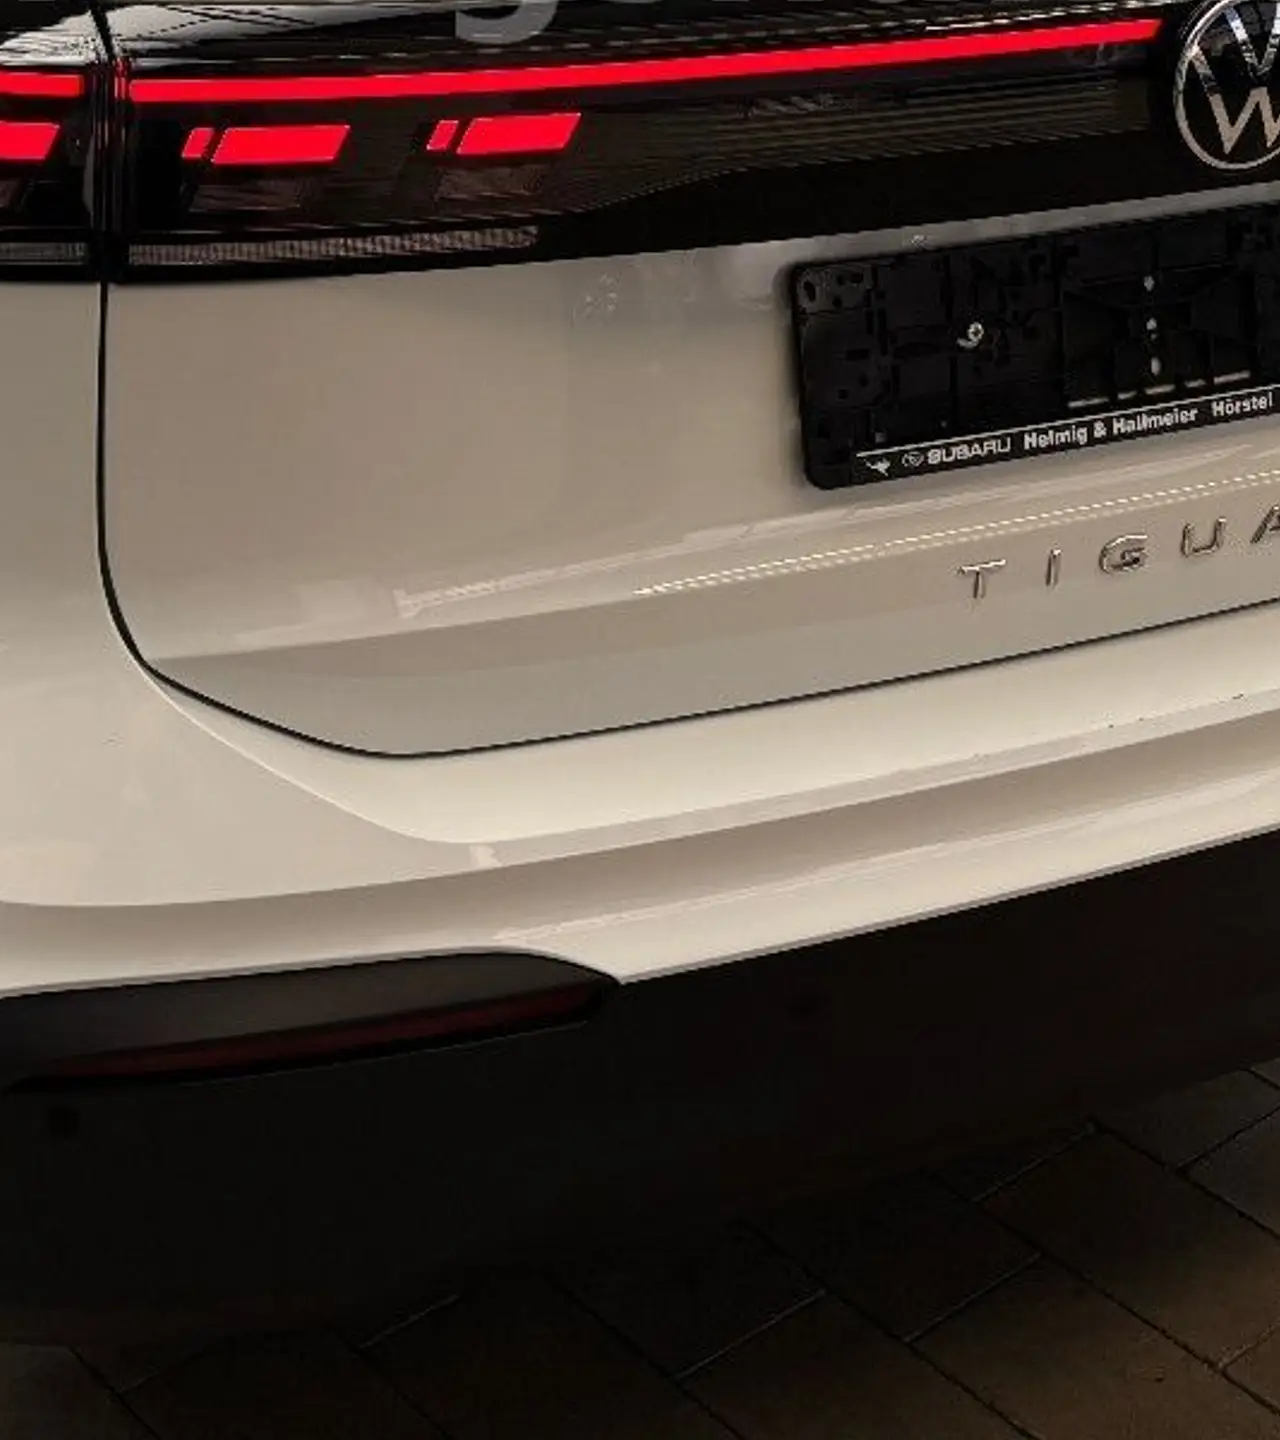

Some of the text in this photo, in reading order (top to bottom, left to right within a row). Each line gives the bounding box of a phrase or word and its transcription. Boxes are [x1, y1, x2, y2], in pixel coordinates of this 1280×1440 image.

[928, 438, 1011, 464] SUBARU
[1023, 426, 1088, 450] Helmig
[1093, 421, 1107, 439] &
[1112, 405, 1199, 436] Hallmeier
[1211, 391, 1273, 417] Hörstel
